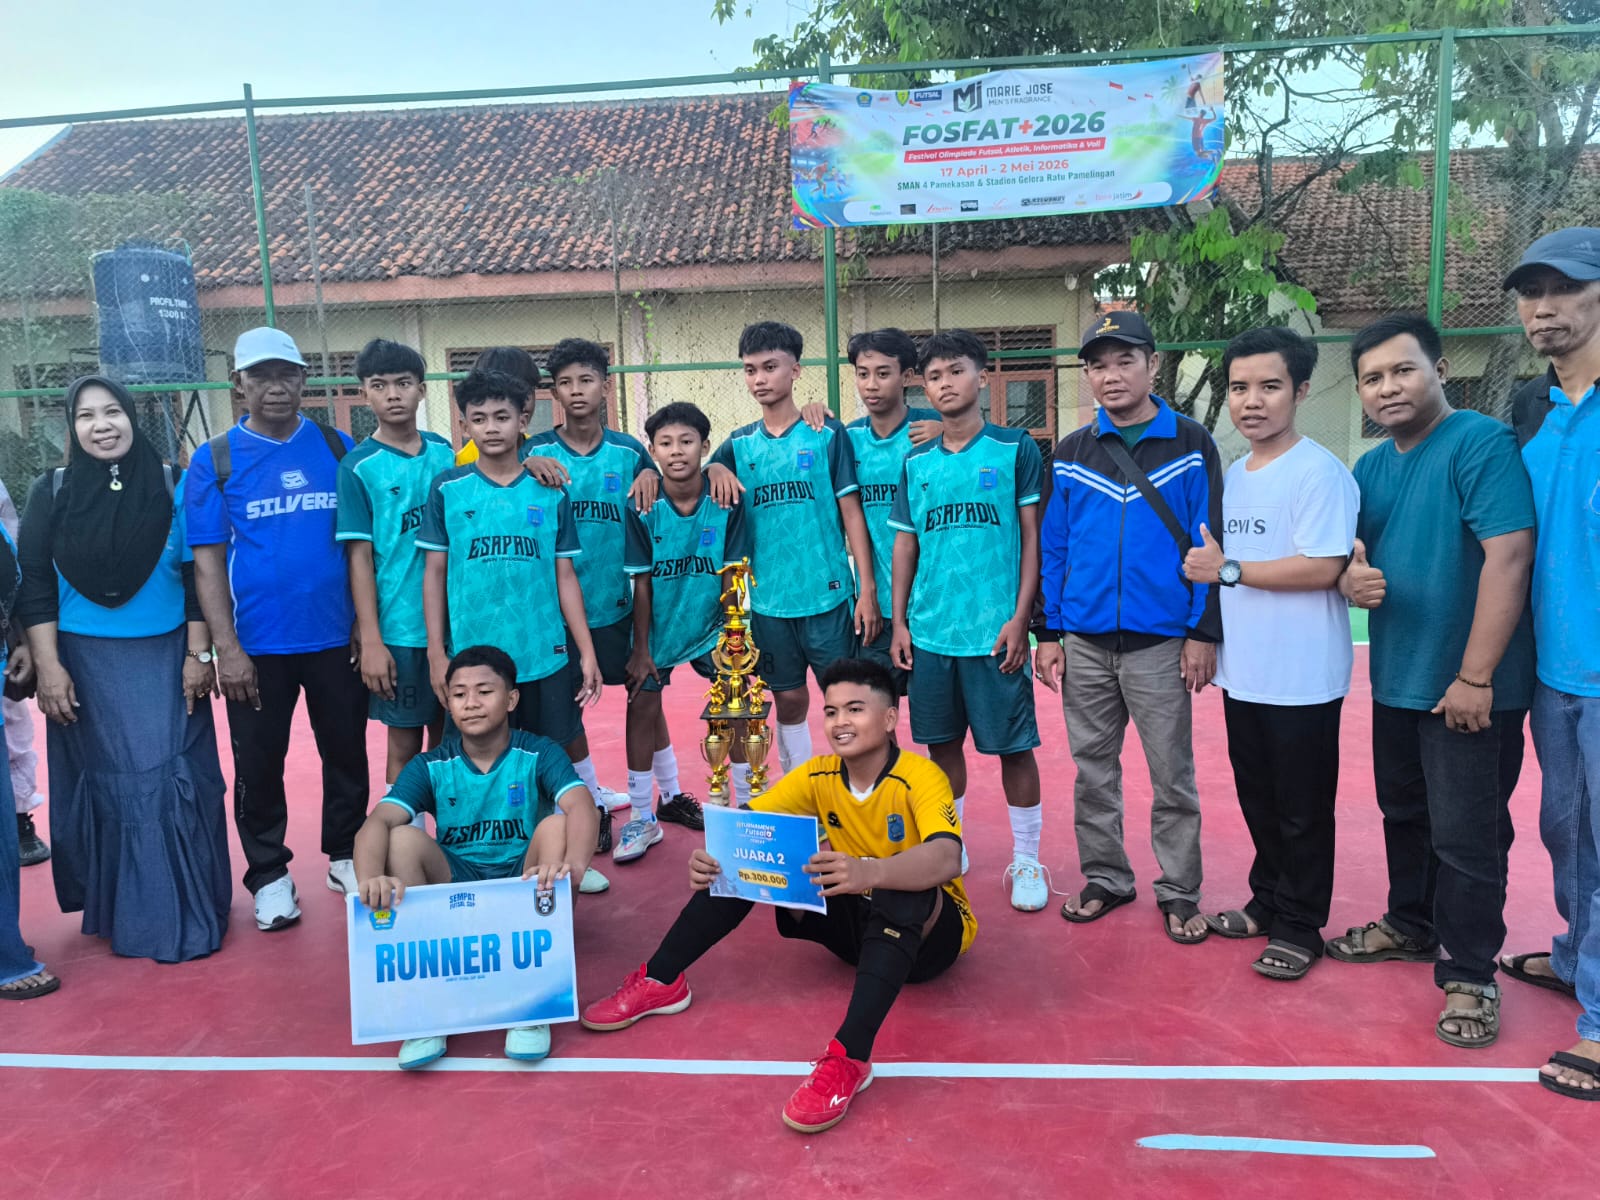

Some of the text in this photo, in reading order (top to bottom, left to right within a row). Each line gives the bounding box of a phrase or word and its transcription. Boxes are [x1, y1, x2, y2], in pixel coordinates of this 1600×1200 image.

[915, 91, 941, 100] FUTSAL
[986, 83, 1053, 98] MARIE JOSE
[1011, 96, 1051, 104] FRAGRANCE
[908, 152, 937, 160] Festival
[940, 167, 953, 177] 17
[957, 164, 988, 178] April
[1000, 163, 1008, 173] 2
[1011, 160, 1034, 172] Mei
[1038, 159, 1069, 171] 2026
[897, 181, 920, 191] SMAN
[930, 180, 975, 189] Pamekasan
[986, 176, 1016, 186] Stadion
[1019, 175, 1044, 184] Gelora
[1047, 173, 1065, 182] Ratu
[753, 480, 815, 507] ESAPADU
[924, 502, 1001, 533] ESAPADU
[467, 535, 541, 560] ESAPADU
[440, 818, 529, 846] ESAPADU
[733, 848, 785, 865] JUARA 2
[449, 892, 475, 903] SEMPAT
[376, 929, 553, 983] RUNNER UP
